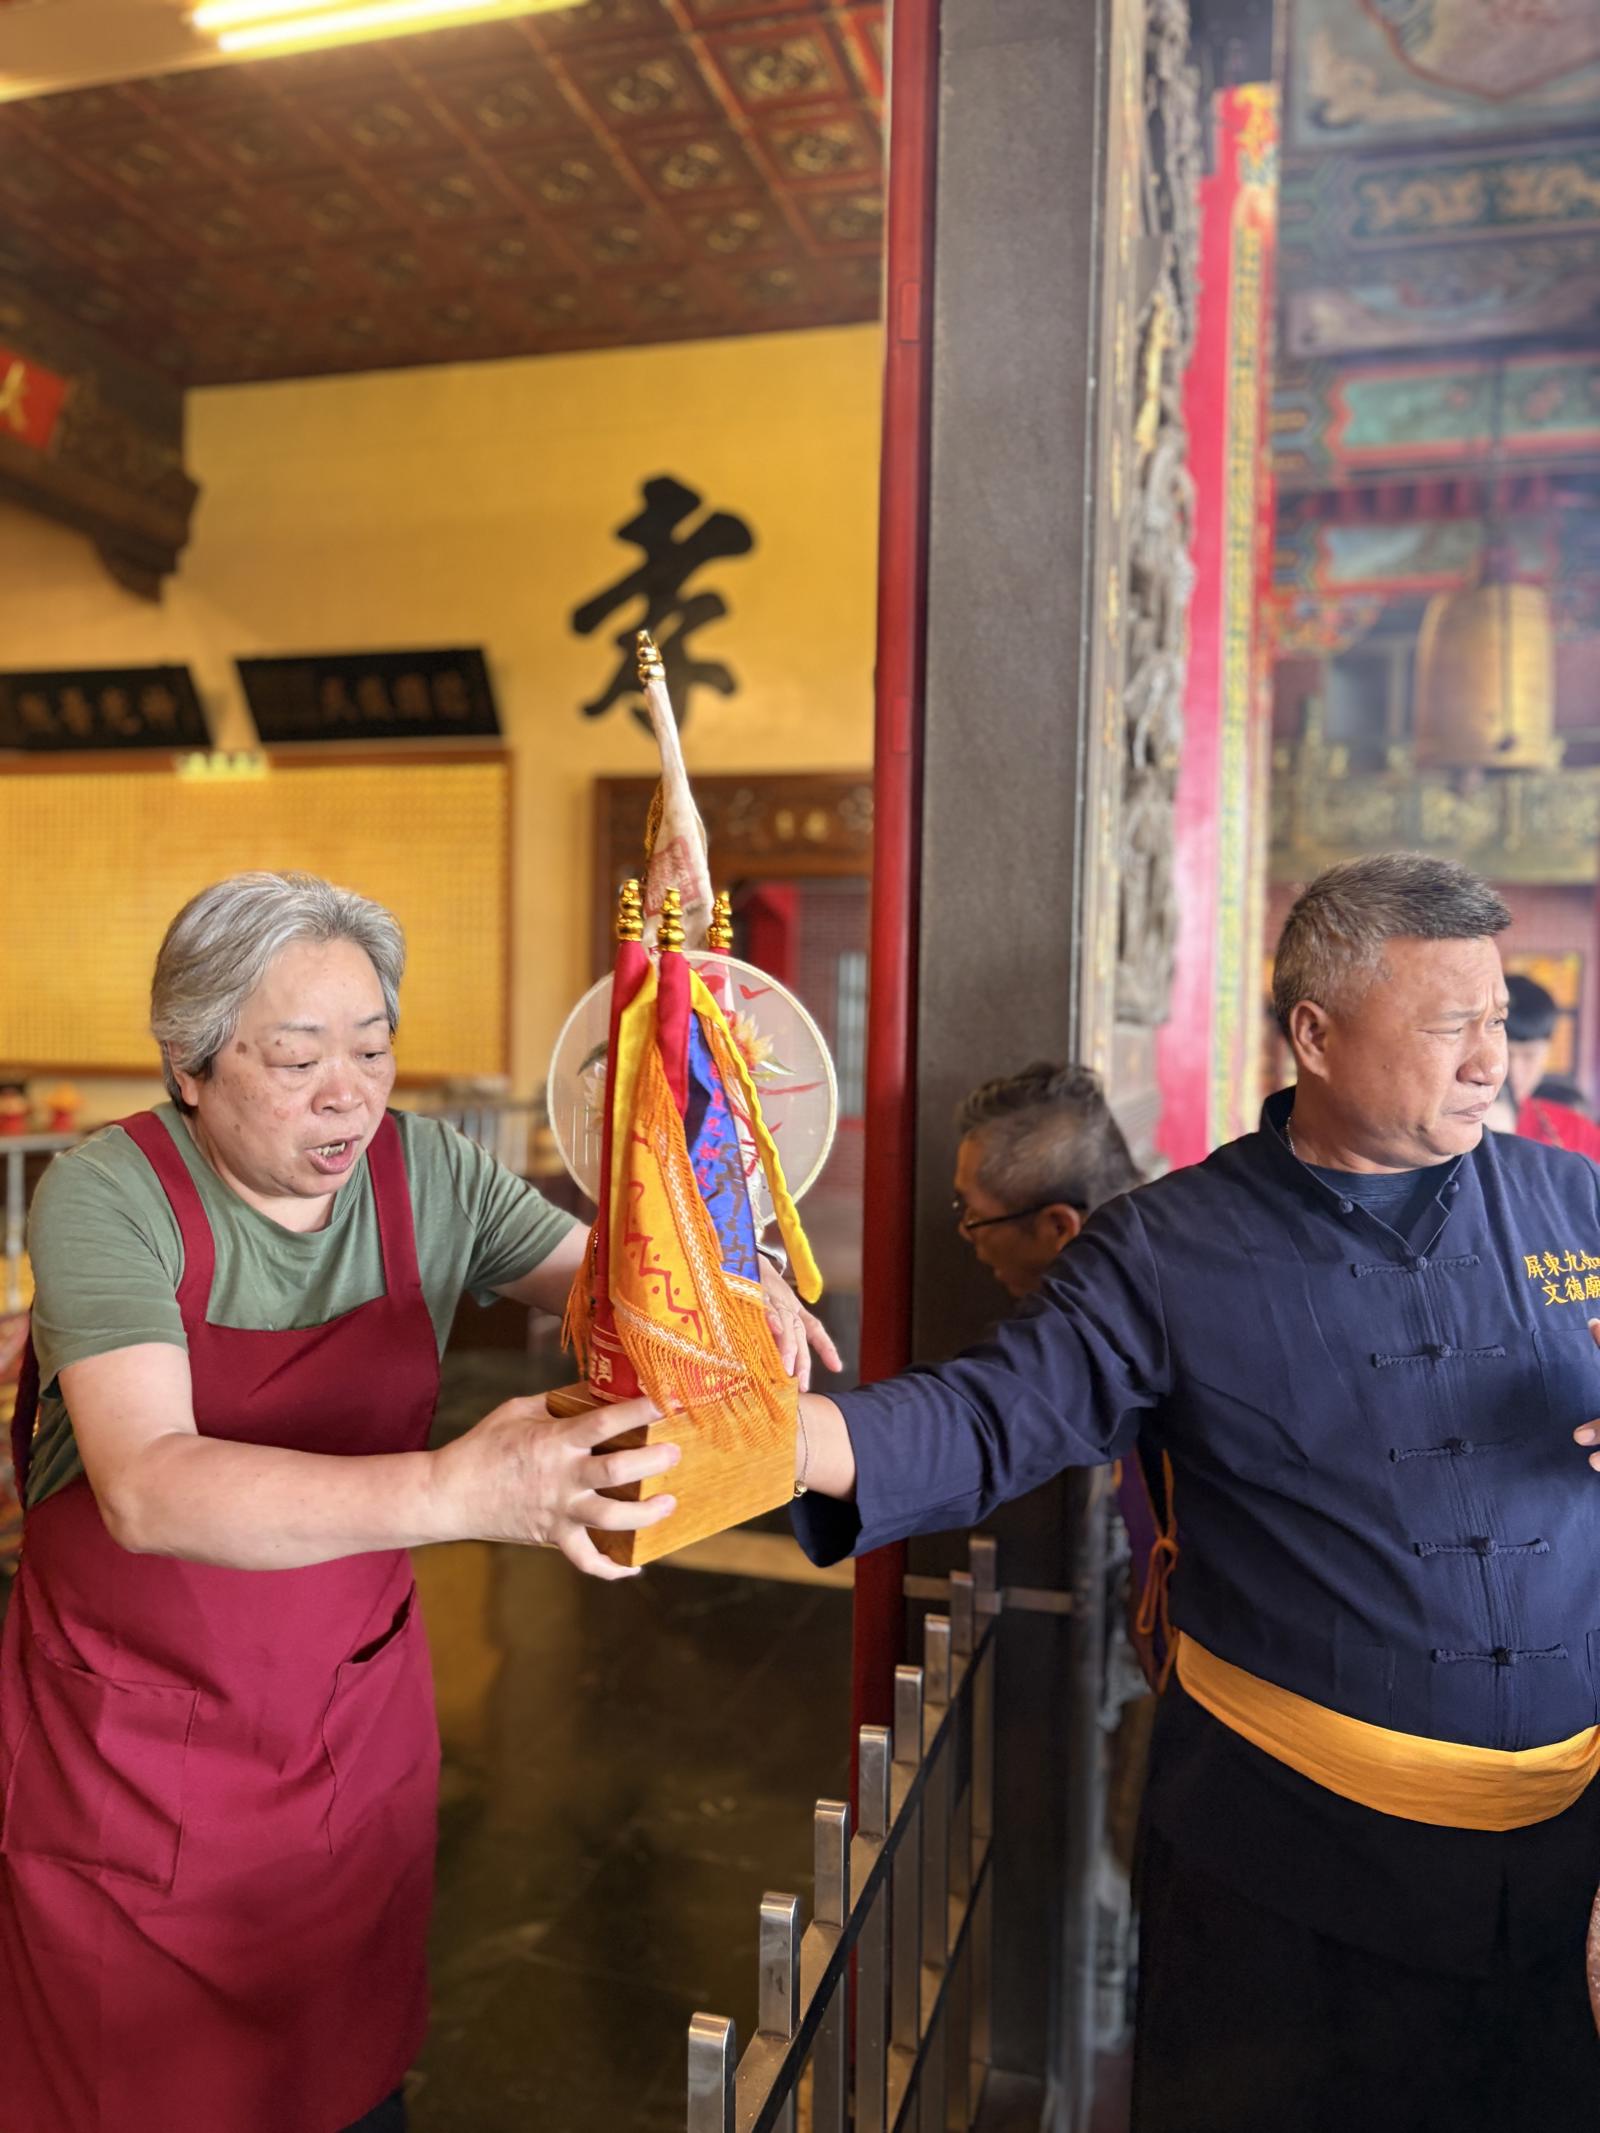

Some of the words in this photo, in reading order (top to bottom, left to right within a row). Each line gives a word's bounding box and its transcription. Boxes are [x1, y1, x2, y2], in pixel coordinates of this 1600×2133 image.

[1523, 1249, 1600, 1280] 屏東九如
[1541, 1273, 1600, 1307] 文德廟
